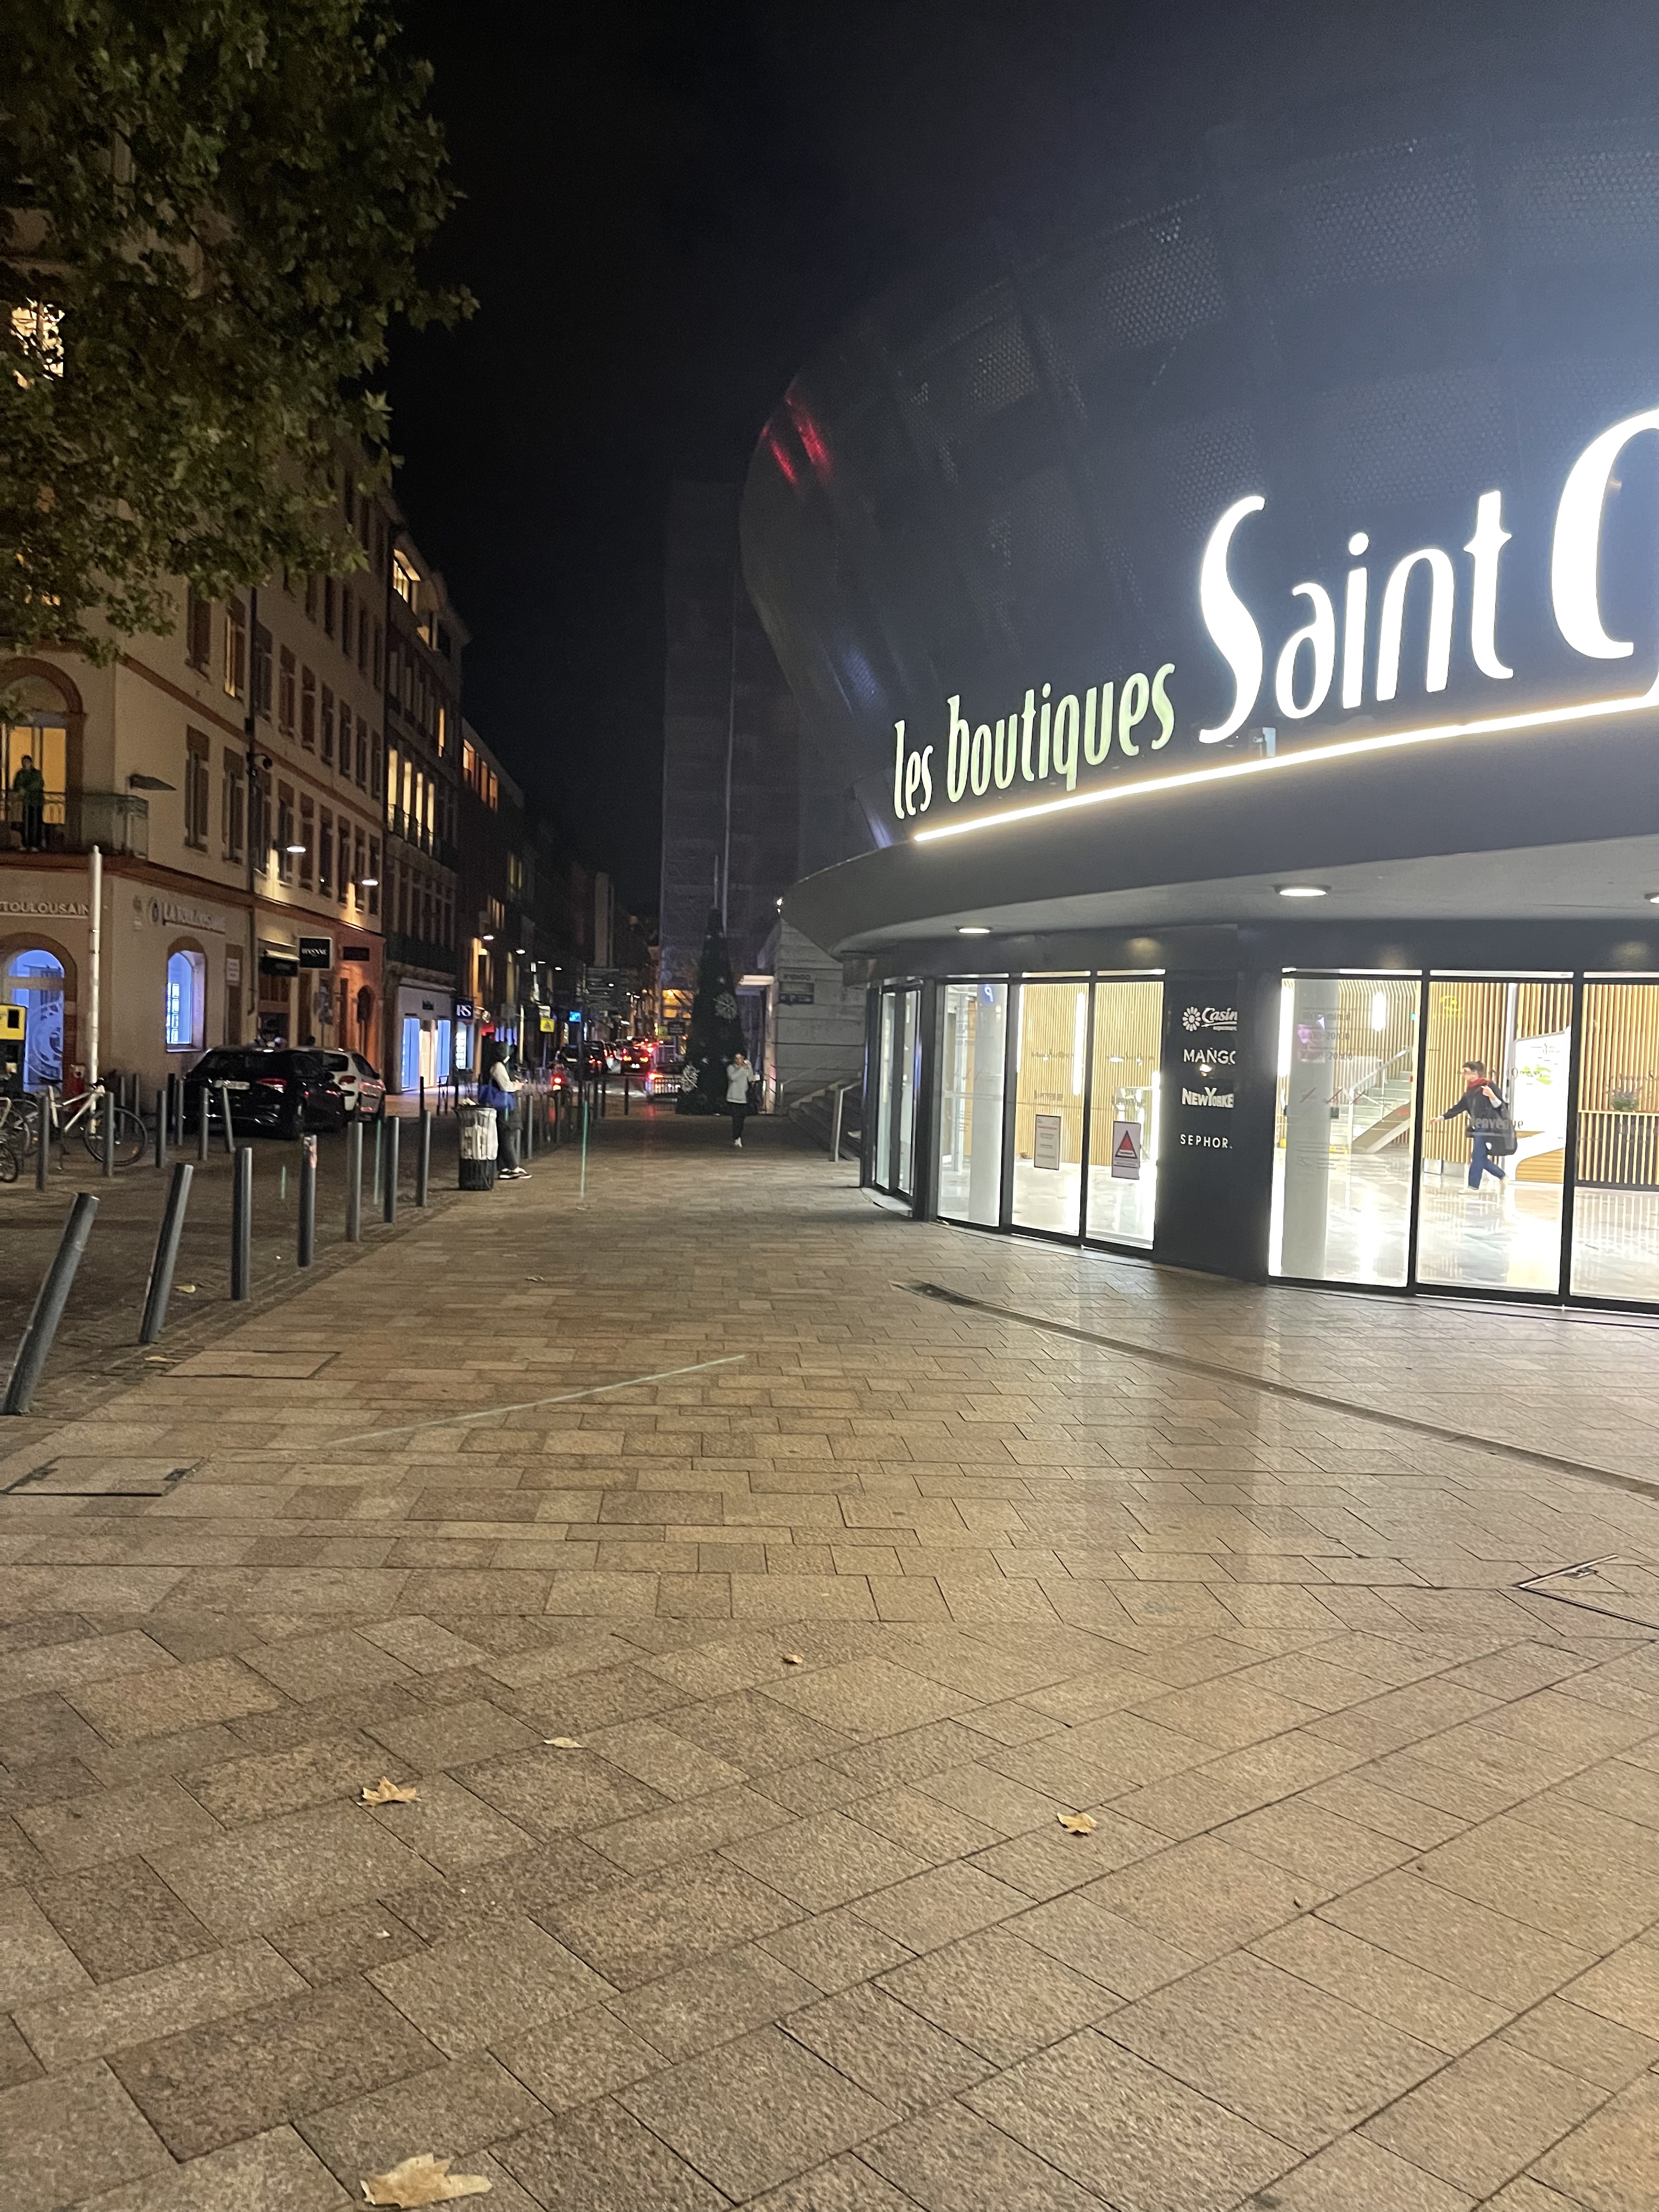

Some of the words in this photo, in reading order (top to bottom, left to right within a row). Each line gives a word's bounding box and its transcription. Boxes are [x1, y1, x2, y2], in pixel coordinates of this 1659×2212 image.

[894, 720, 933, 819] les
[947, 663, 1175, 803] boutiques
[1199, 490, 1514, 744] Saint
[1180, 1134, 1233, 1149] SEPHOR
